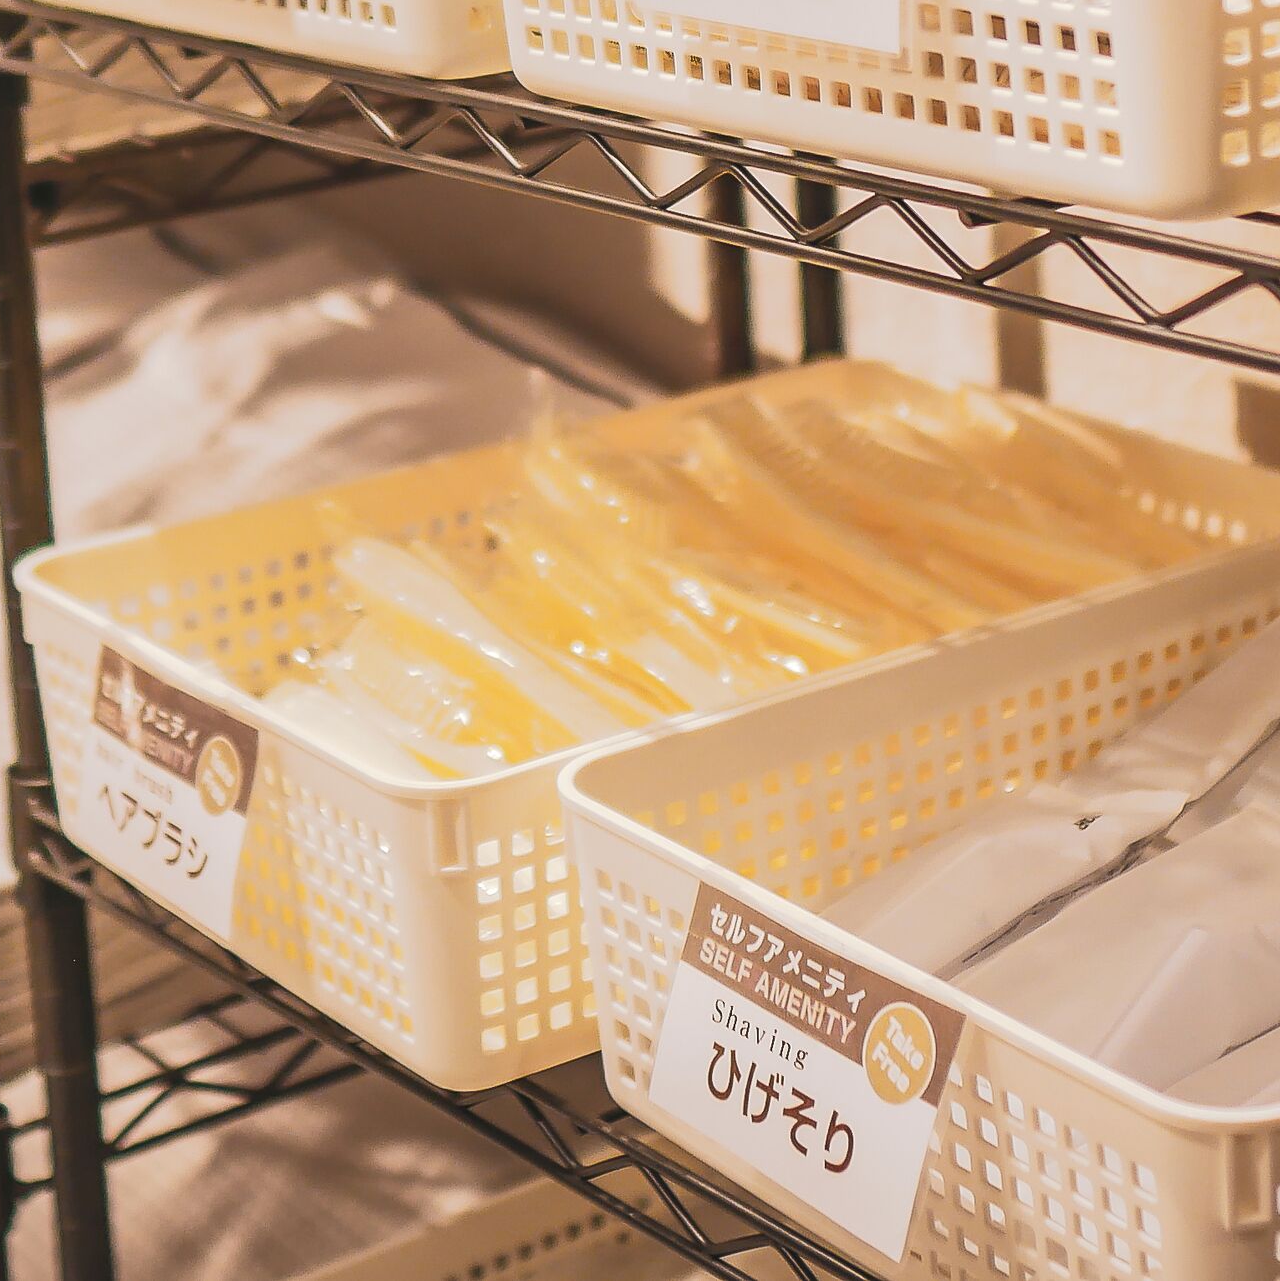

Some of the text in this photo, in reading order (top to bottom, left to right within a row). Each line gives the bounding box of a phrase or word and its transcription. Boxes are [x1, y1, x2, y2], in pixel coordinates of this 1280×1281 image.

[99, 783, 209, 878] ヘアブラシ
[699, 938, 858, 1044] SELF AMENITY
[709, 903, 867, 1014] セルフアメニティ
[710, 997, 810, 1071] Shaving
[872, 1042, 911, 1094] Free
[886, 1016, 926, 1071] Take
[707, 1041, 856, 1173] ひげそり
